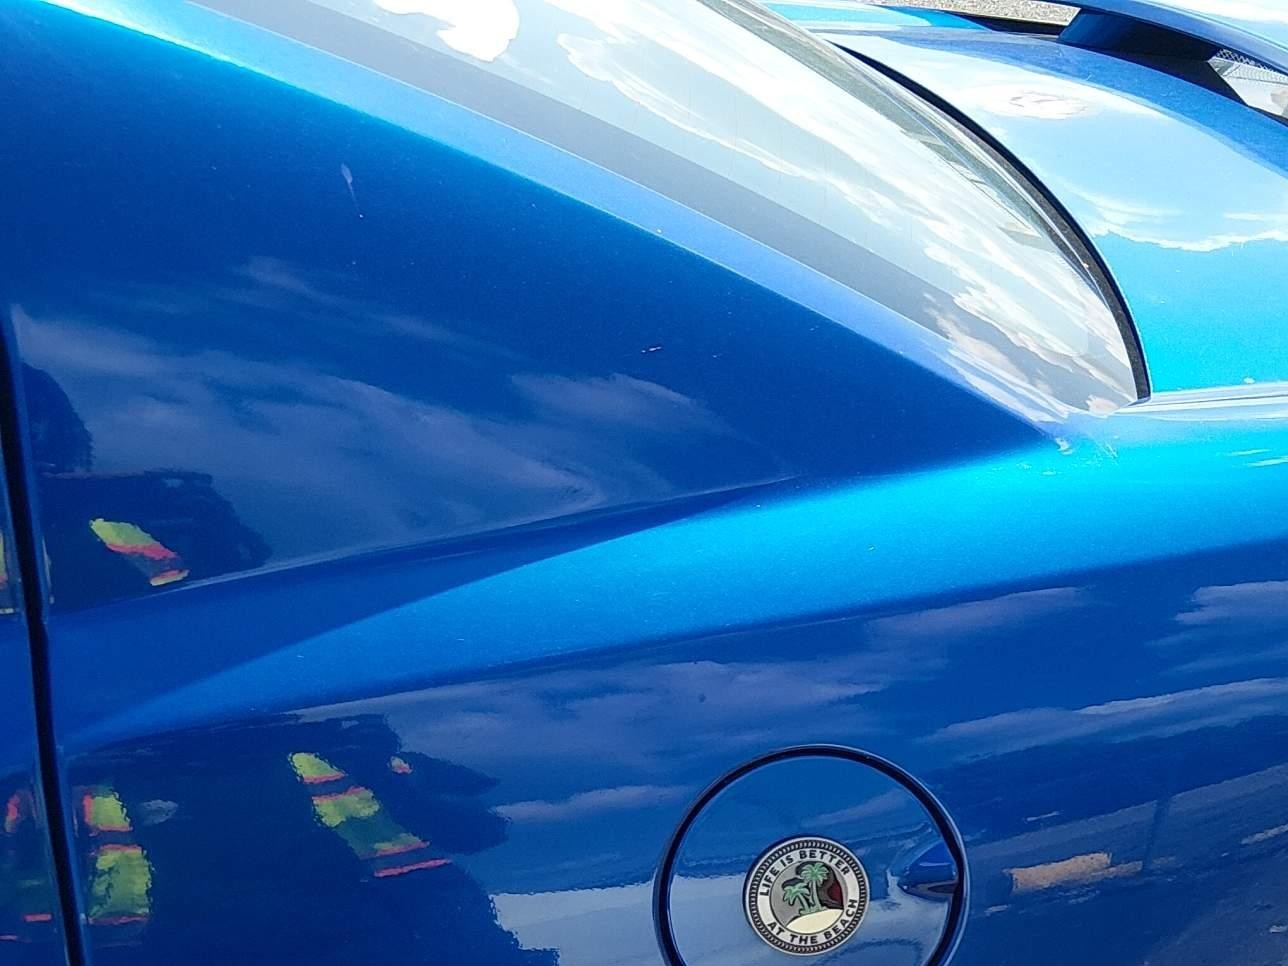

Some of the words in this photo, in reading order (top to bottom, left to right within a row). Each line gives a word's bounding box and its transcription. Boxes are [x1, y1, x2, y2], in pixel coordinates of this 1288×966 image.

[760, 867, 779, 897] LIFE
[781, 855, 794, 867] IS
[799, 849, 850, 875] BETTER
[767, 921, 785, 936] AT
[789, 935, 818, 945] THE
[823, 898, 858, 940] BEACH
